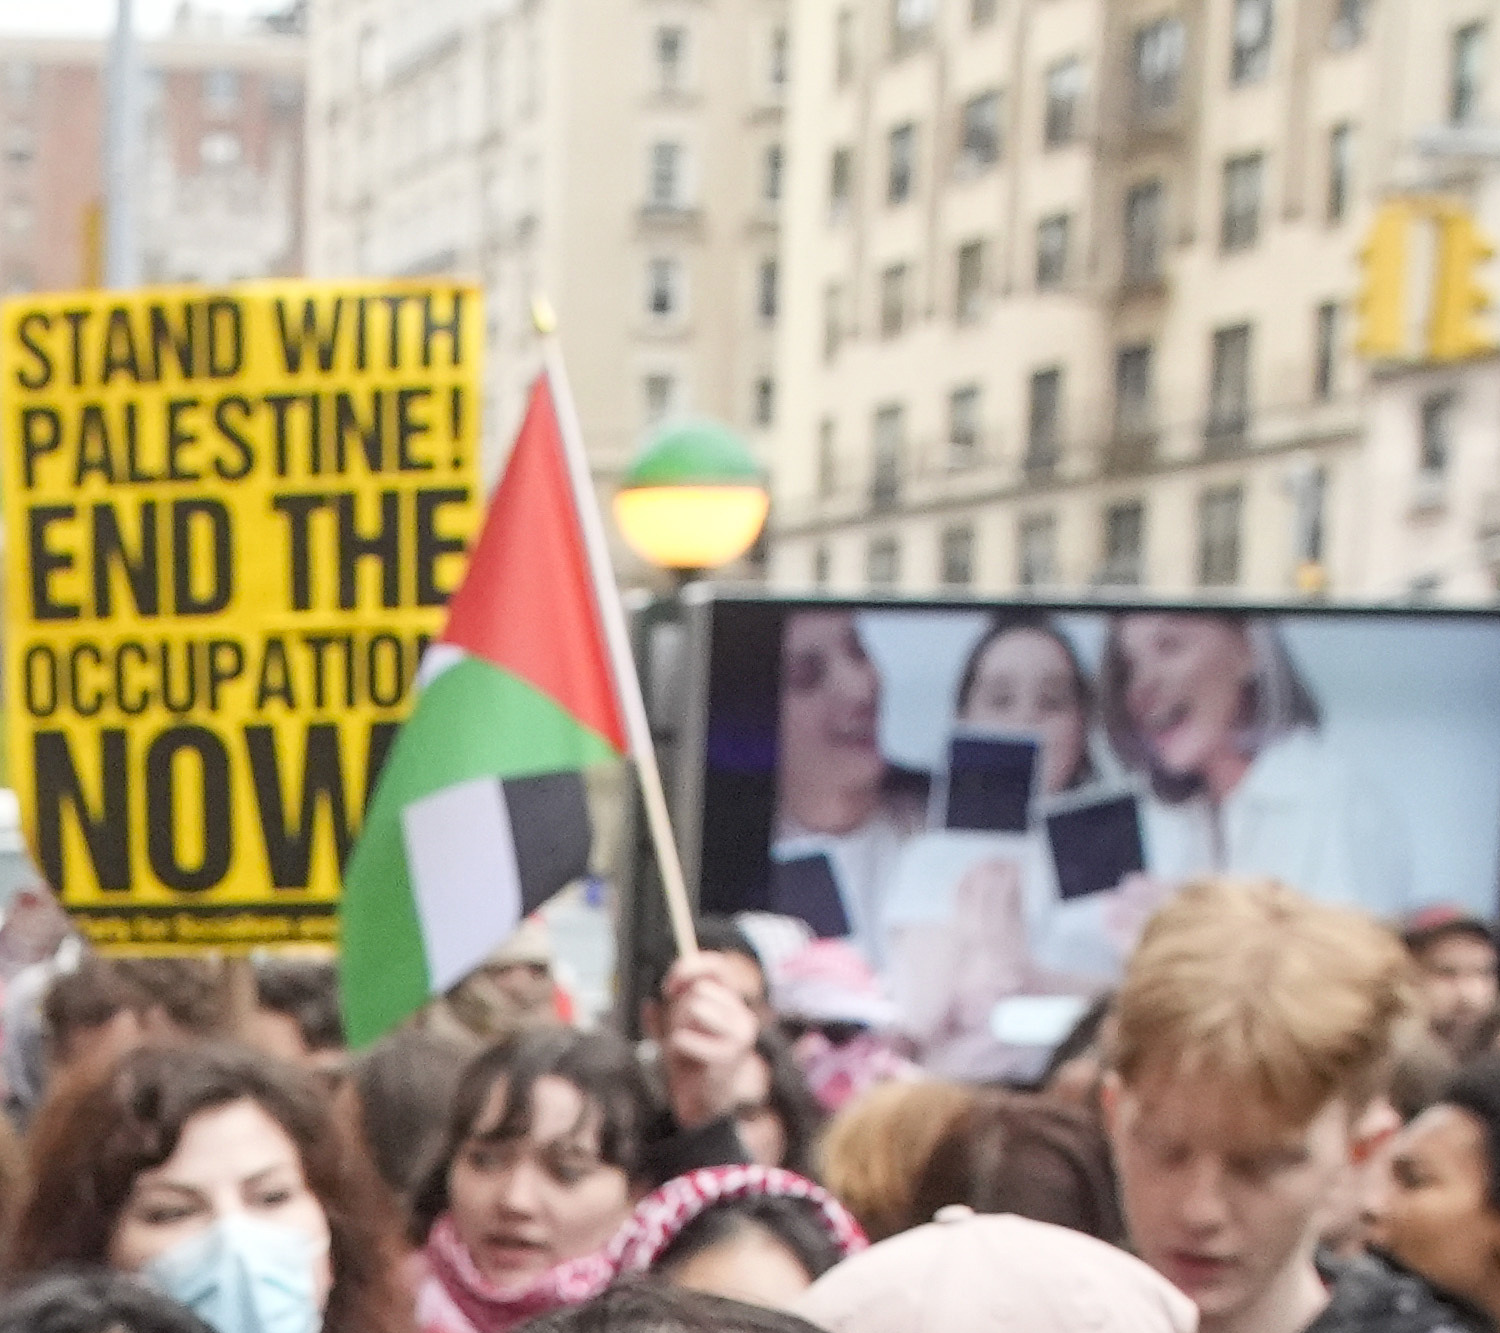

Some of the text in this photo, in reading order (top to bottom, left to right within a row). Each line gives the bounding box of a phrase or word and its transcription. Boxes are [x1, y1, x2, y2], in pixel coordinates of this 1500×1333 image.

[17, 290, 462, 390] STAND WITH
[22, 386, 463, 489] PALESTINE!
[28, 488, 469, 621] END THE
